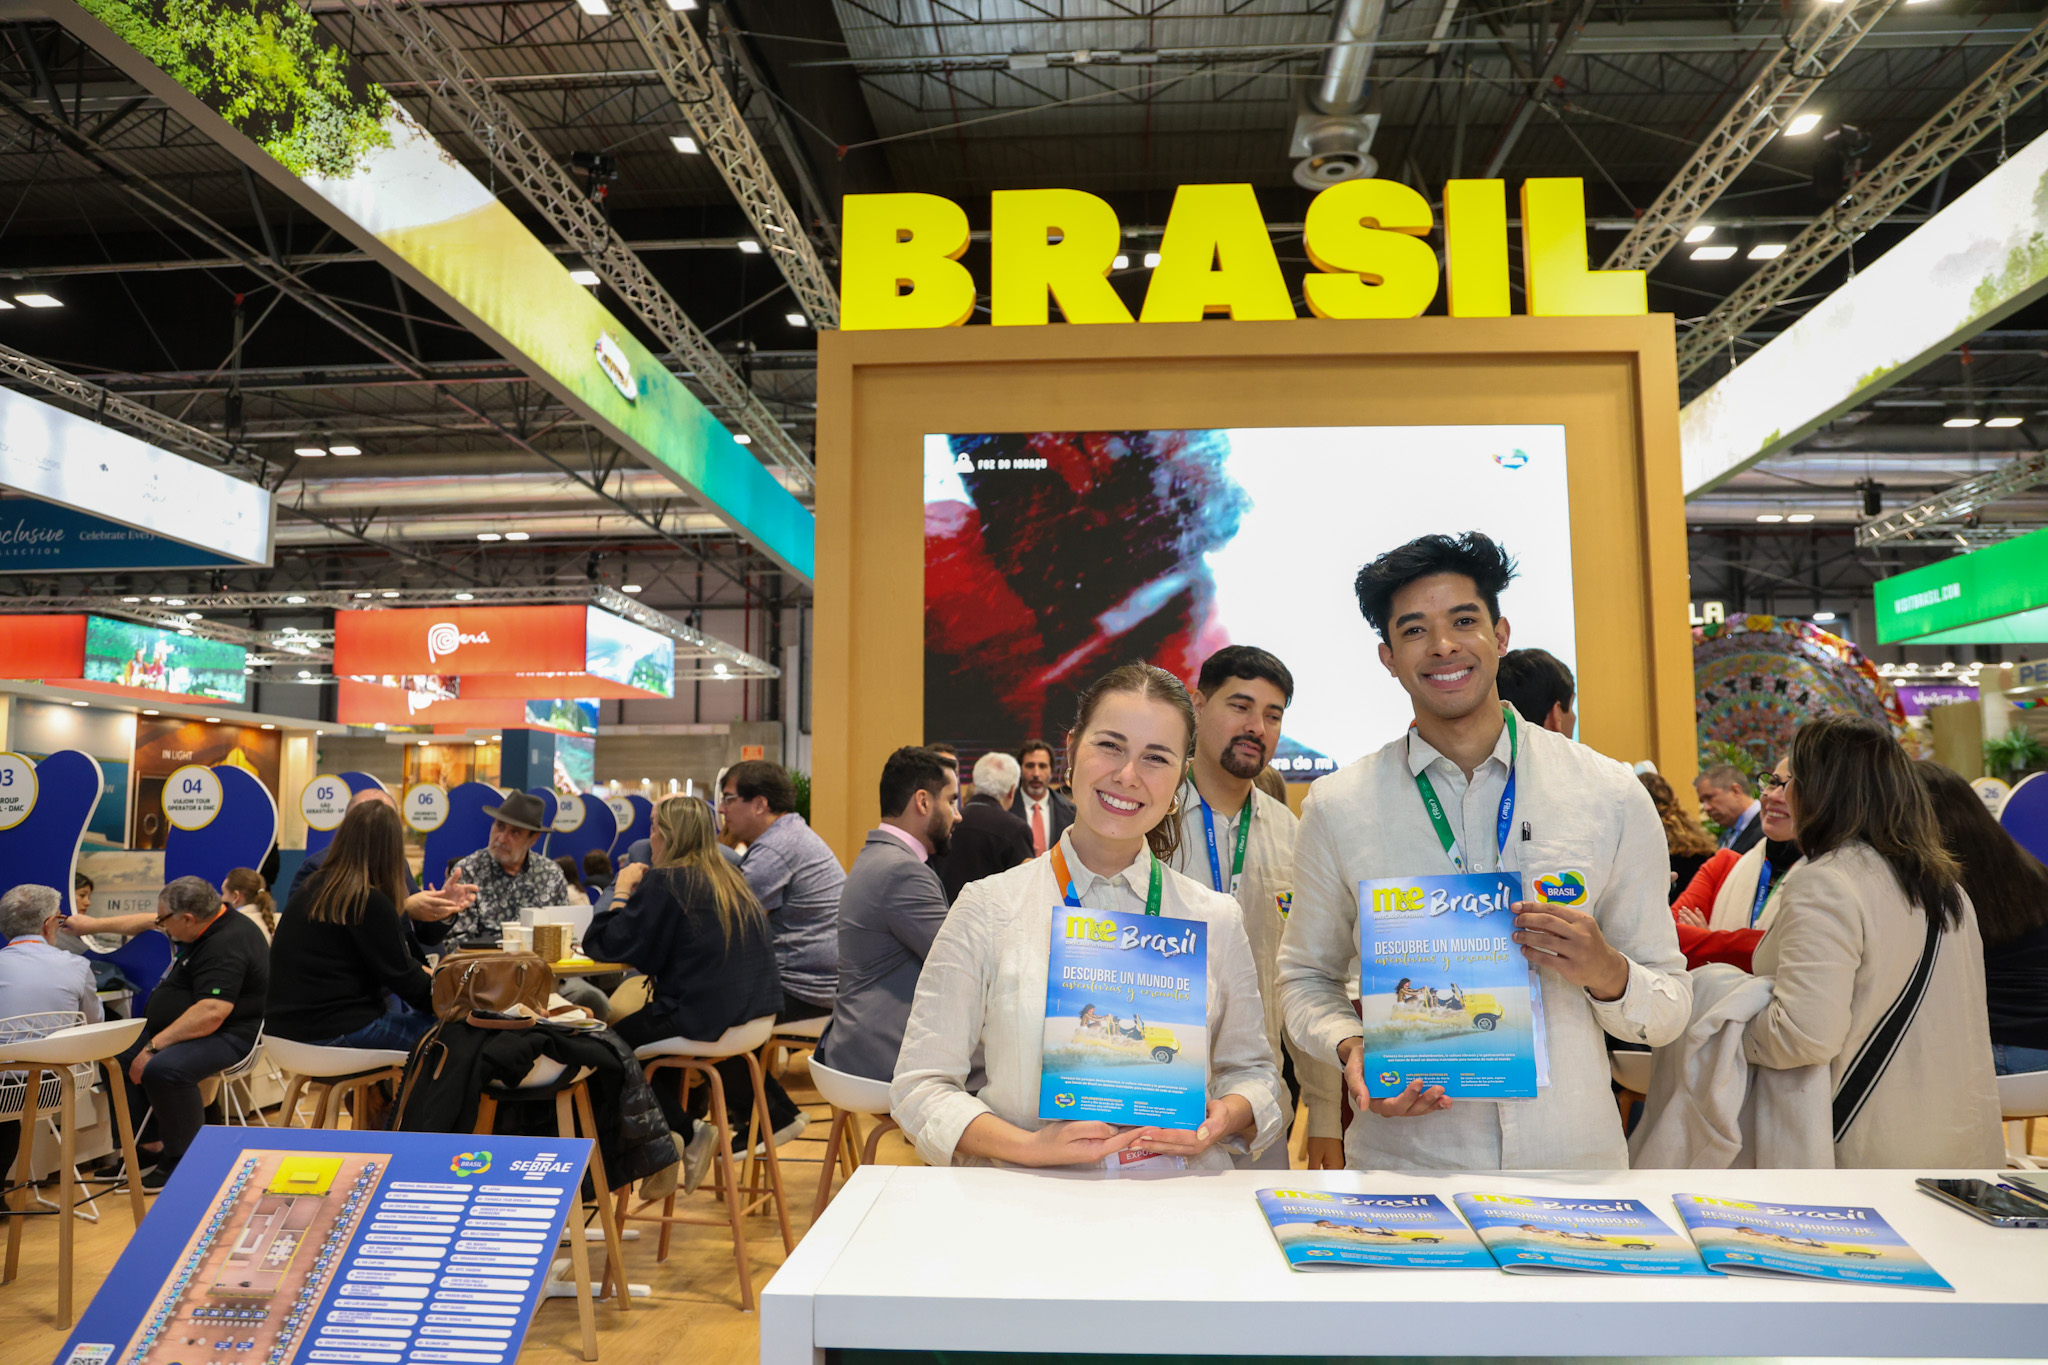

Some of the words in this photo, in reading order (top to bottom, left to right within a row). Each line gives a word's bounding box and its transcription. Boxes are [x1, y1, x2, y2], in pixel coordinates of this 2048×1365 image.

[839, 178, 1648, 331] BRASIL
[978, 459, 995, 470] FOZ
[998, 459, 1011, 469] DO
[0, 519, 64, 545] clusive
[80, 531, 125, 540] Celebrate
[1894, 582, 1960, 614] VISITBRASIL.COM
[428, 623, 490, 663] Perú
[162, 750, 170, 759] IN
[172, 751, 193, 760] LIGHT
[1293, 756, 1312, 770] de
[183, 779, 202, 793] 04
[1985, 788, 1999, 798] 26
[317, 787, 333, 800] 05
[418, 793, 433, 805] 06
[9, 804, 24, 812] DMC
[561, 802, 572, 810] 08
[1548, 888, 1577, 897] BRASIL
[108, 900, 121, 911] IN
[123, 900, 152, 912] STEP
[1373, 886, 1425, 912] m&e
[1428, 882, 1511, 918] Brasil
[1066, 916, 1117, 942] m&e
[1119, 926, 1197, 958] Brasil
[1375, 940, 1429, 956] DESCUBRE
[1433, 939, 1448, 953] UN
[1450, 938, 1491, 953] MUNDO
[1494, 938, 1507, 951] DE
[1375, 953, 1436, 967] aventuras
[1442, 957, 1450, 972] y
[1456, 950, 1510, 964] encantos
[1063, 966, 1117, 984] DESCUBRE
[1120, 972, 1135, 985] UN
[1137, 973, 1174, 990] MUNDO
[1176, 978, 1190, 991] DE
[1062, 979, 1121, 993] aventuras
[1127, 988, 1135, 1002] y
[1140, 989, 1190, 1001] encantos
[1126, 1150, 1157, 1161] EXPOS
[509, 1160, 574, 1172] SEBRAE
[1341, 1197, 1429, 1208] Brasil
[1542, 1201, 1634, 1213] Brasil
[1283, 1206, 1344, 1217] DESCUBRE
[1370, 1212, 1417, 1220] MUNDO
[1484, 1209, 1550, 1222] DESCUBRE
[1554, 1216, 1572, 1224] UN
[1575, 1217, 1621, 1225] MUNDO
[1765, 1207, 1867, 1221] Brasil
[1701, 1210, 1770, 1226] DESCUBRE
[1775, 1221, 1795, 1229] UN
[1798, 1223, 1848, 1233] MUNDO
[1853, 1226, 1873, 1234] DE
